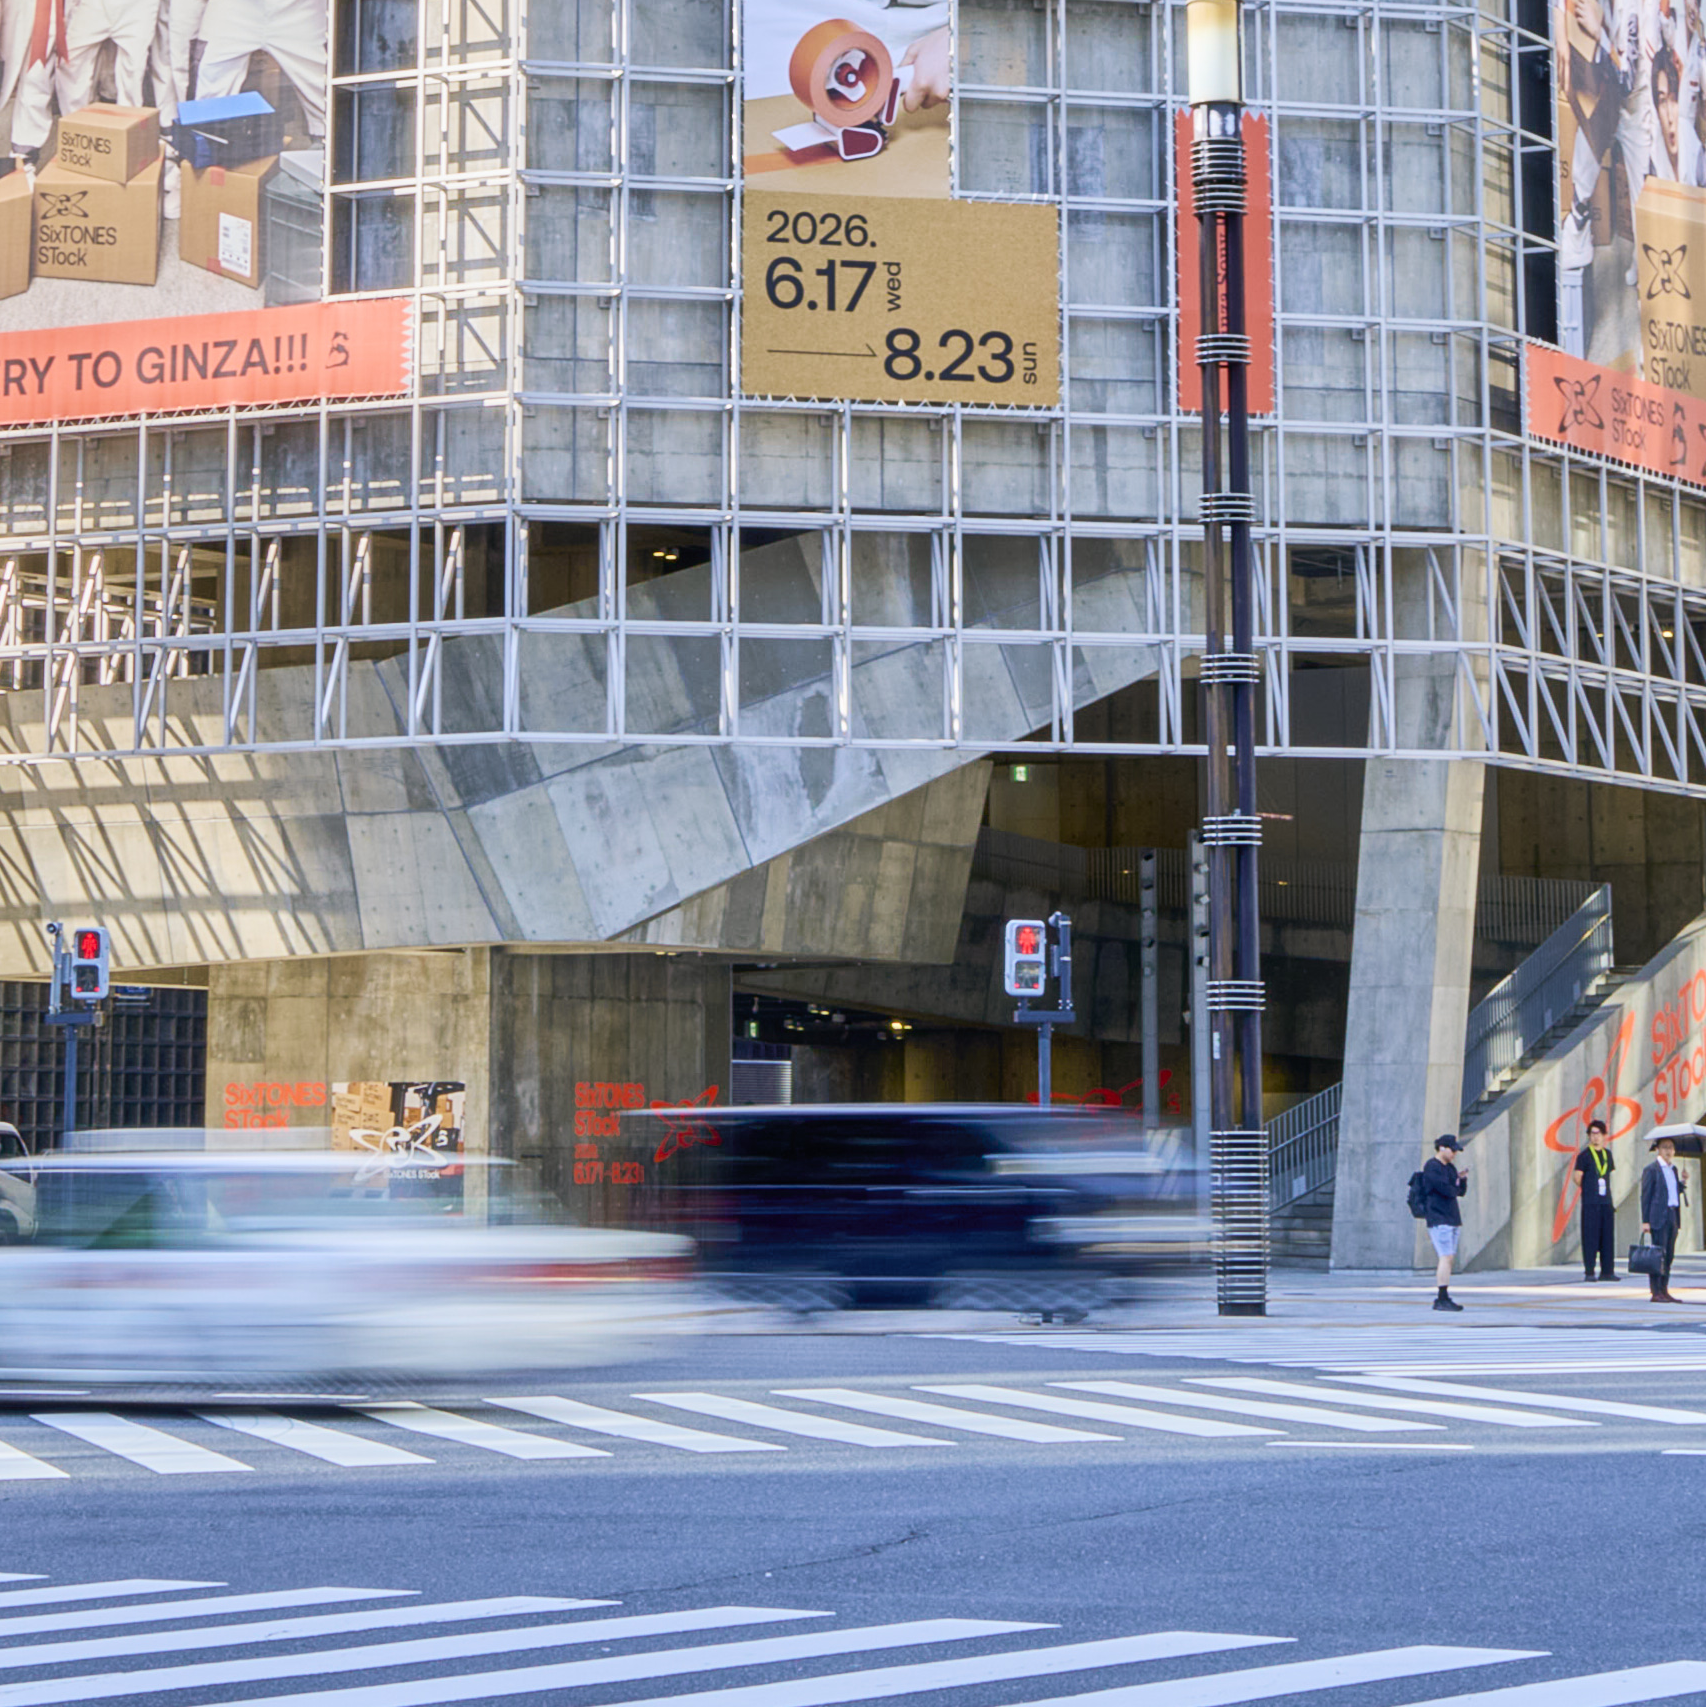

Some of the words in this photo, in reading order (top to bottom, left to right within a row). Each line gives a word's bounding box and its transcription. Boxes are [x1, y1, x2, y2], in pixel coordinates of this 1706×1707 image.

[60, 132, 112, 155] SixTONES
[60, 148, 92, 169] STock
[38, 224, 118, 246] SixTONES
[766, 210, 877, 247] 2026.
[38, 245, 89, 267] STock
[765, 256, 877, 312] 6.17
[882, 261, 902, 312] wed
[68, 349, 123, 391] TO
[135, 332, 309, 386] GINZA!!!
[883, 327, 1015, 383] 8.23
[1023, 342, 1037, 385] sun
[1650, 356, 1692, 391] STock
[1611, 387, 1665, 427] SixTONES
[1612, 419, 1646, 452] STock
[224, 1082, 327, 1107] SixTONES
[223, 1109, 291, 1132] STock
